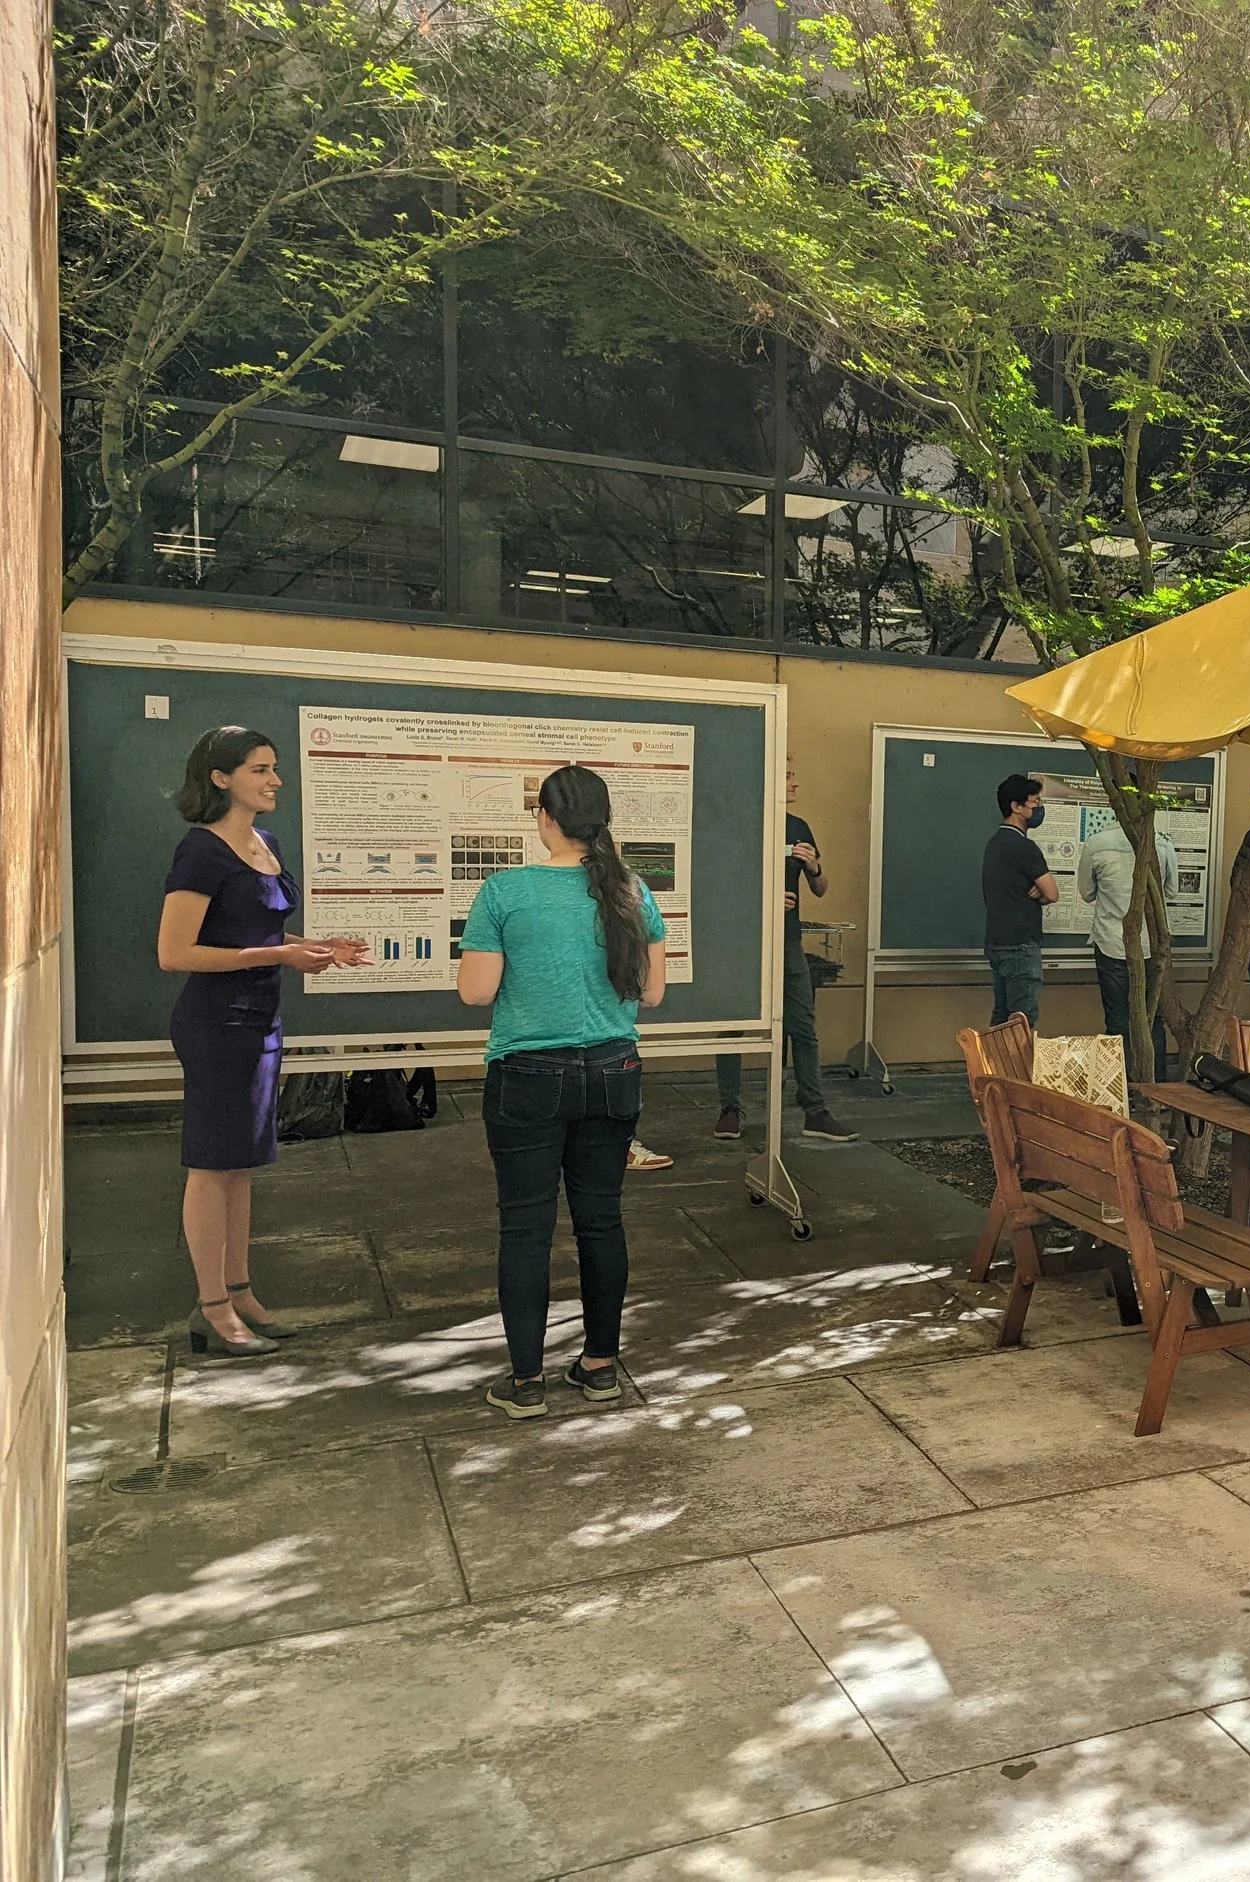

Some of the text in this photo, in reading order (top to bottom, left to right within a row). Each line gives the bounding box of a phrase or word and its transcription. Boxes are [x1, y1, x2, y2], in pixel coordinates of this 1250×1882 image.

[307, 712, 343, 722] Collagen
[344, 714, 384, 724] hydrogels
[386, 717, 425, 726] covalently
[426, 719, 470, 727] crosslinked
[472, 720, 480, 728] by
[483, 721, 533, 730] bioorthogonal
[535, 723, 551, 731] click
[553, 724, 588, 733] chemistry
[610, 727, 651, 735] cell-induced
[653, 729, 689, 737] contraction
[395, 725, 617, 742] while preserving encapsulated corneal stromal cell phenotype
[644, 742, 674, 750] Stanford
